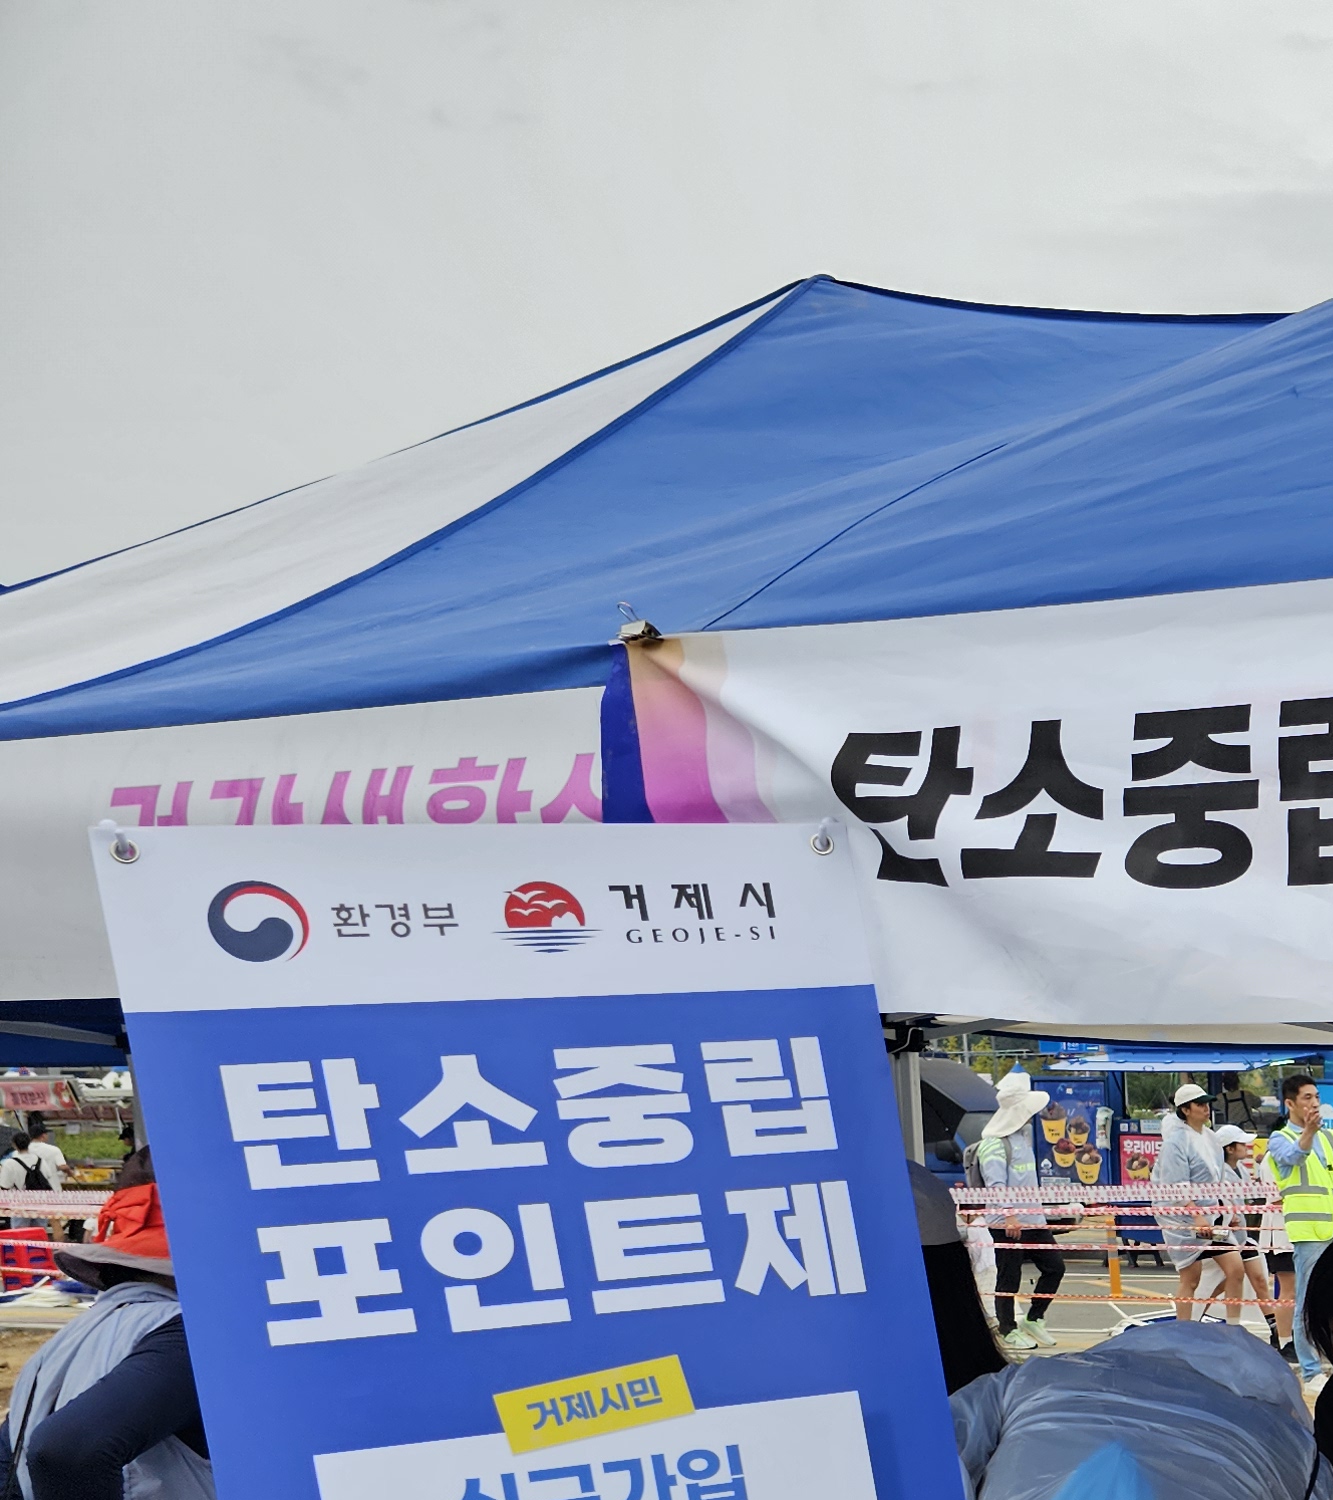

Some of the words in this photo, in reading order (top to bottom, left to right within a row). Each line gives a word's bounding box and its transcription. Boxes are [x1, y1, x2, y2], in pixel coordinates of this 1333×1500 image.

[331, 902, 460, 938] 환경부
[608, 882, 776, 921] 거제시
[625, 926, 776, 944] GEOJE-SI
[219, 1036, 838, 1190] 탄소중립
[257, 1180, 868, 1347] 포인트제
[525, 1375, 664, 1432] 거제시민
